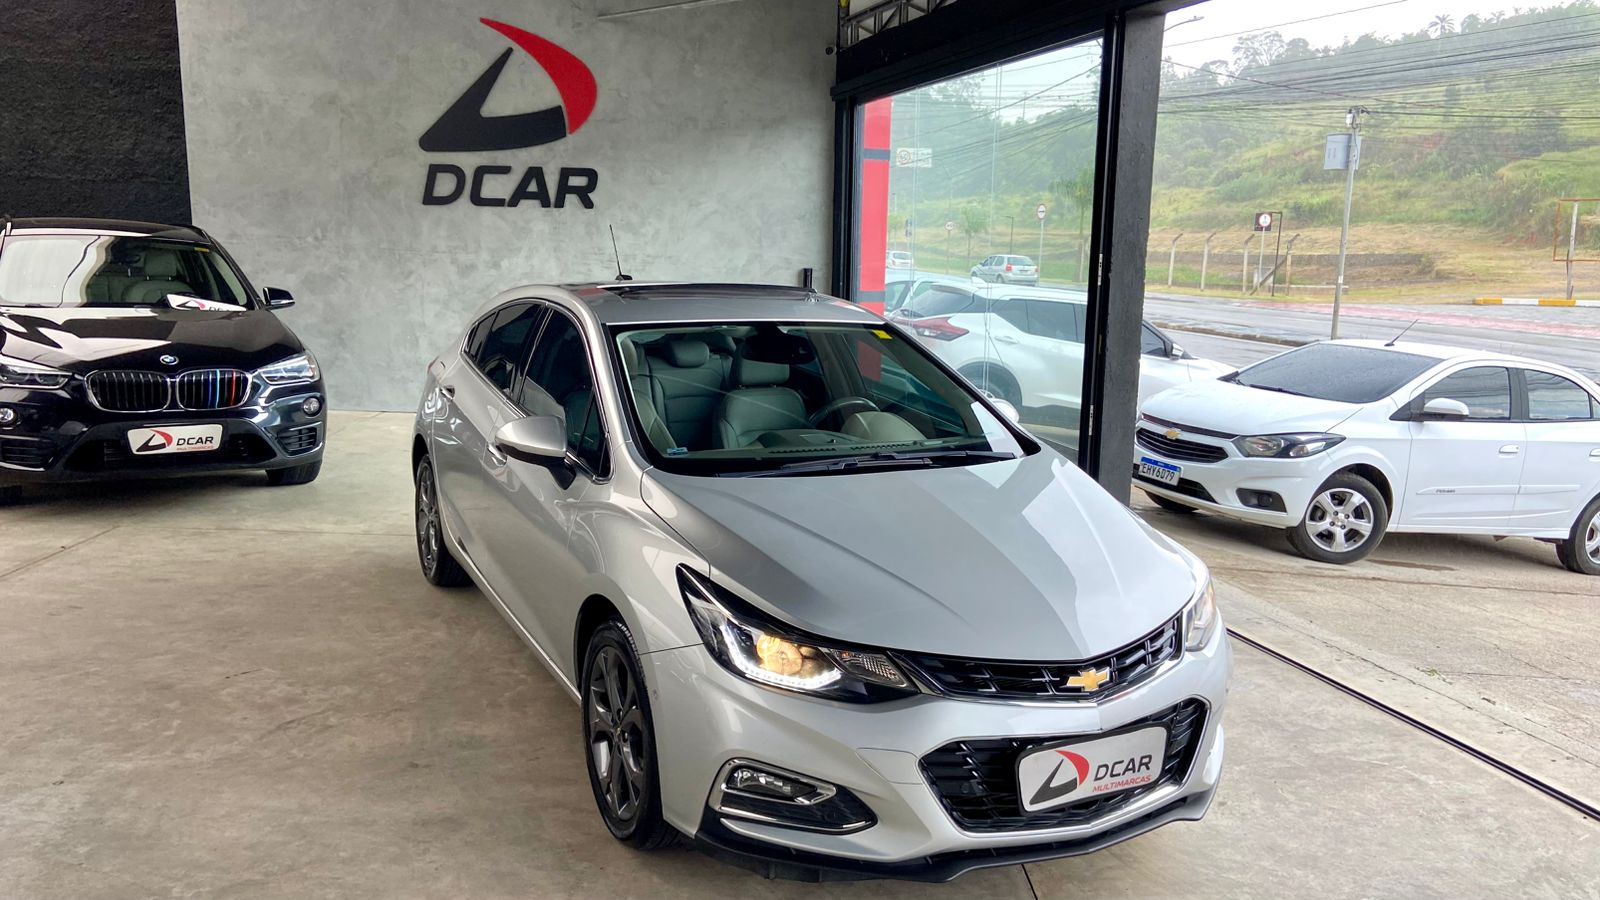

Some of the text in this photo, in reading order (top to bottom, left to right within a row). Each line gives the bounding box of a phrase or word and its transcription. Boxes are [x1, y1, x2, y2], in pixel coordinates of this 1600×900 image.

[422, 163, 599, 209] DCAR
[176, 436, 214, 446] DCAR
[1093, 754, 1153, 782] DCAR
[1092, 774, 1152, 793] MULTIMARCAS
